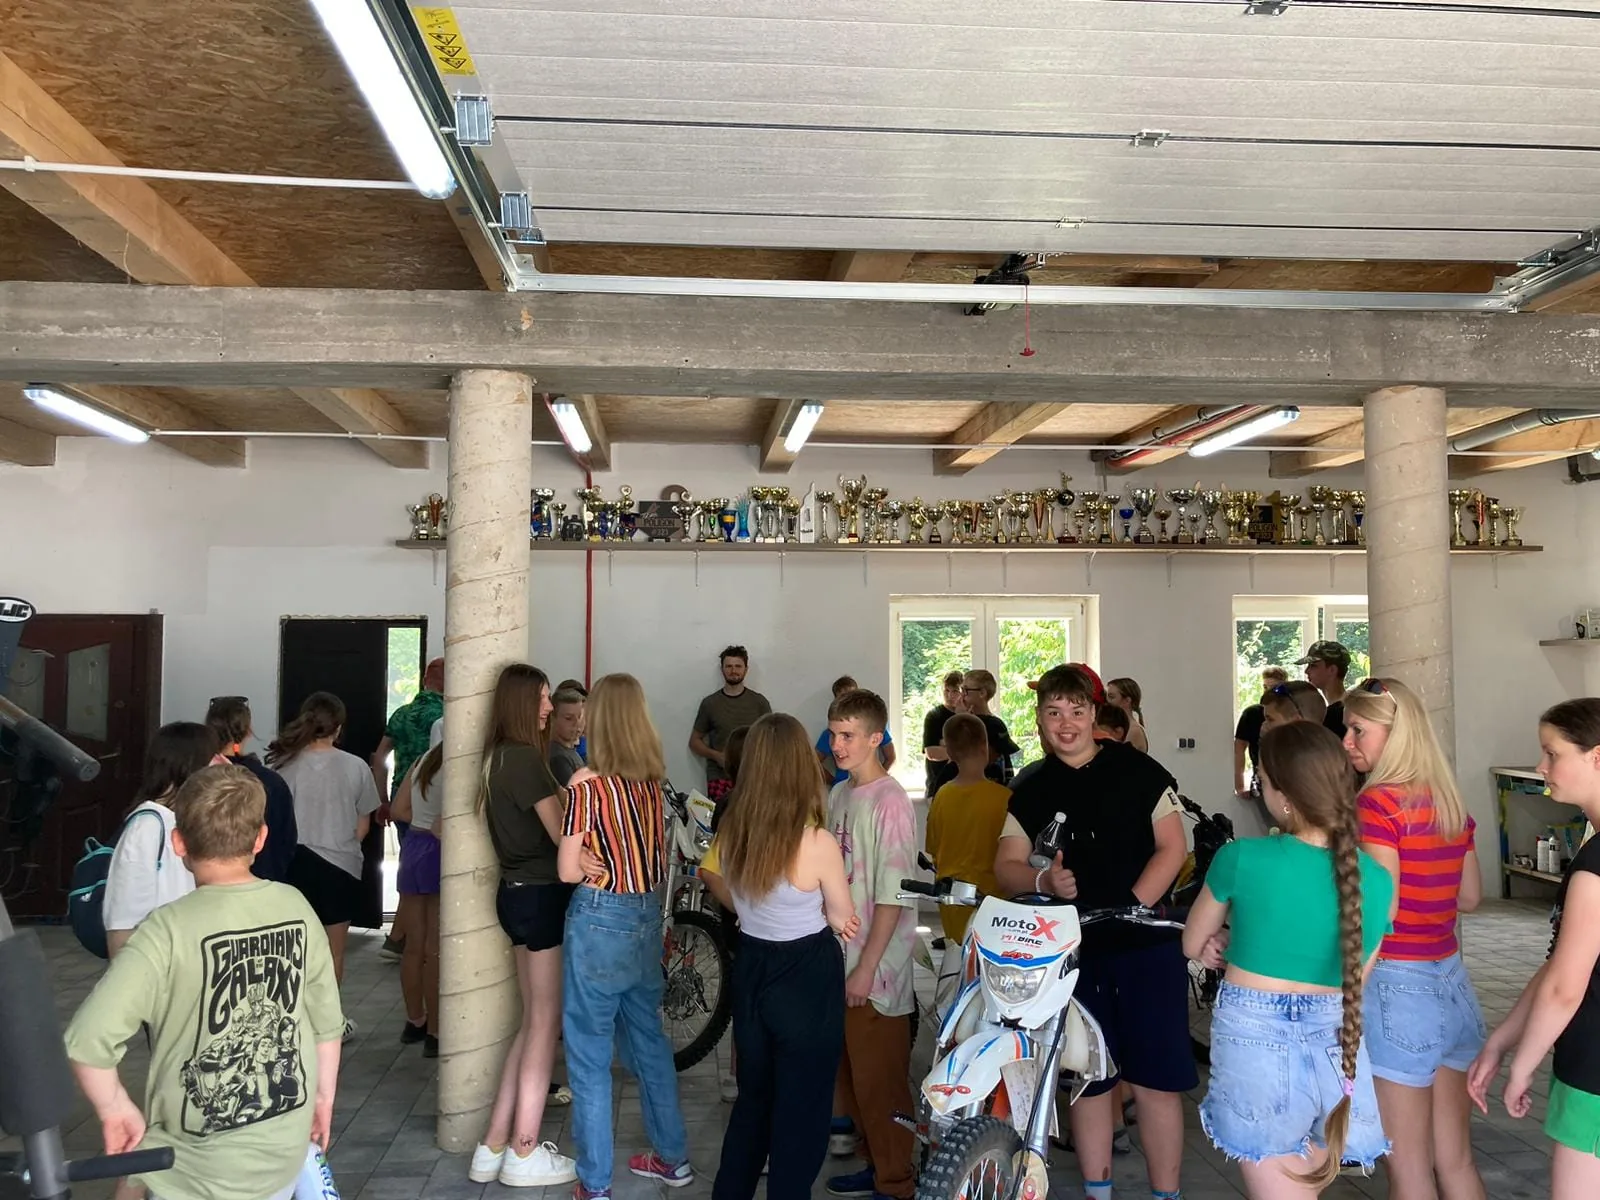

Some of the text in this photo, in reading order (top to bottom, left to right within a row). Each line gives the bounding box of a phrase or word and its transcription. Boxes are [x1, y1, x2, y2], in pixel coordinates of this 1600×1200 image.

[210, 927, 303, 990] GUARDIANS
[991, 914, 1061, 942] MotoX
[207, 956, 301, 1036] GALAXY
